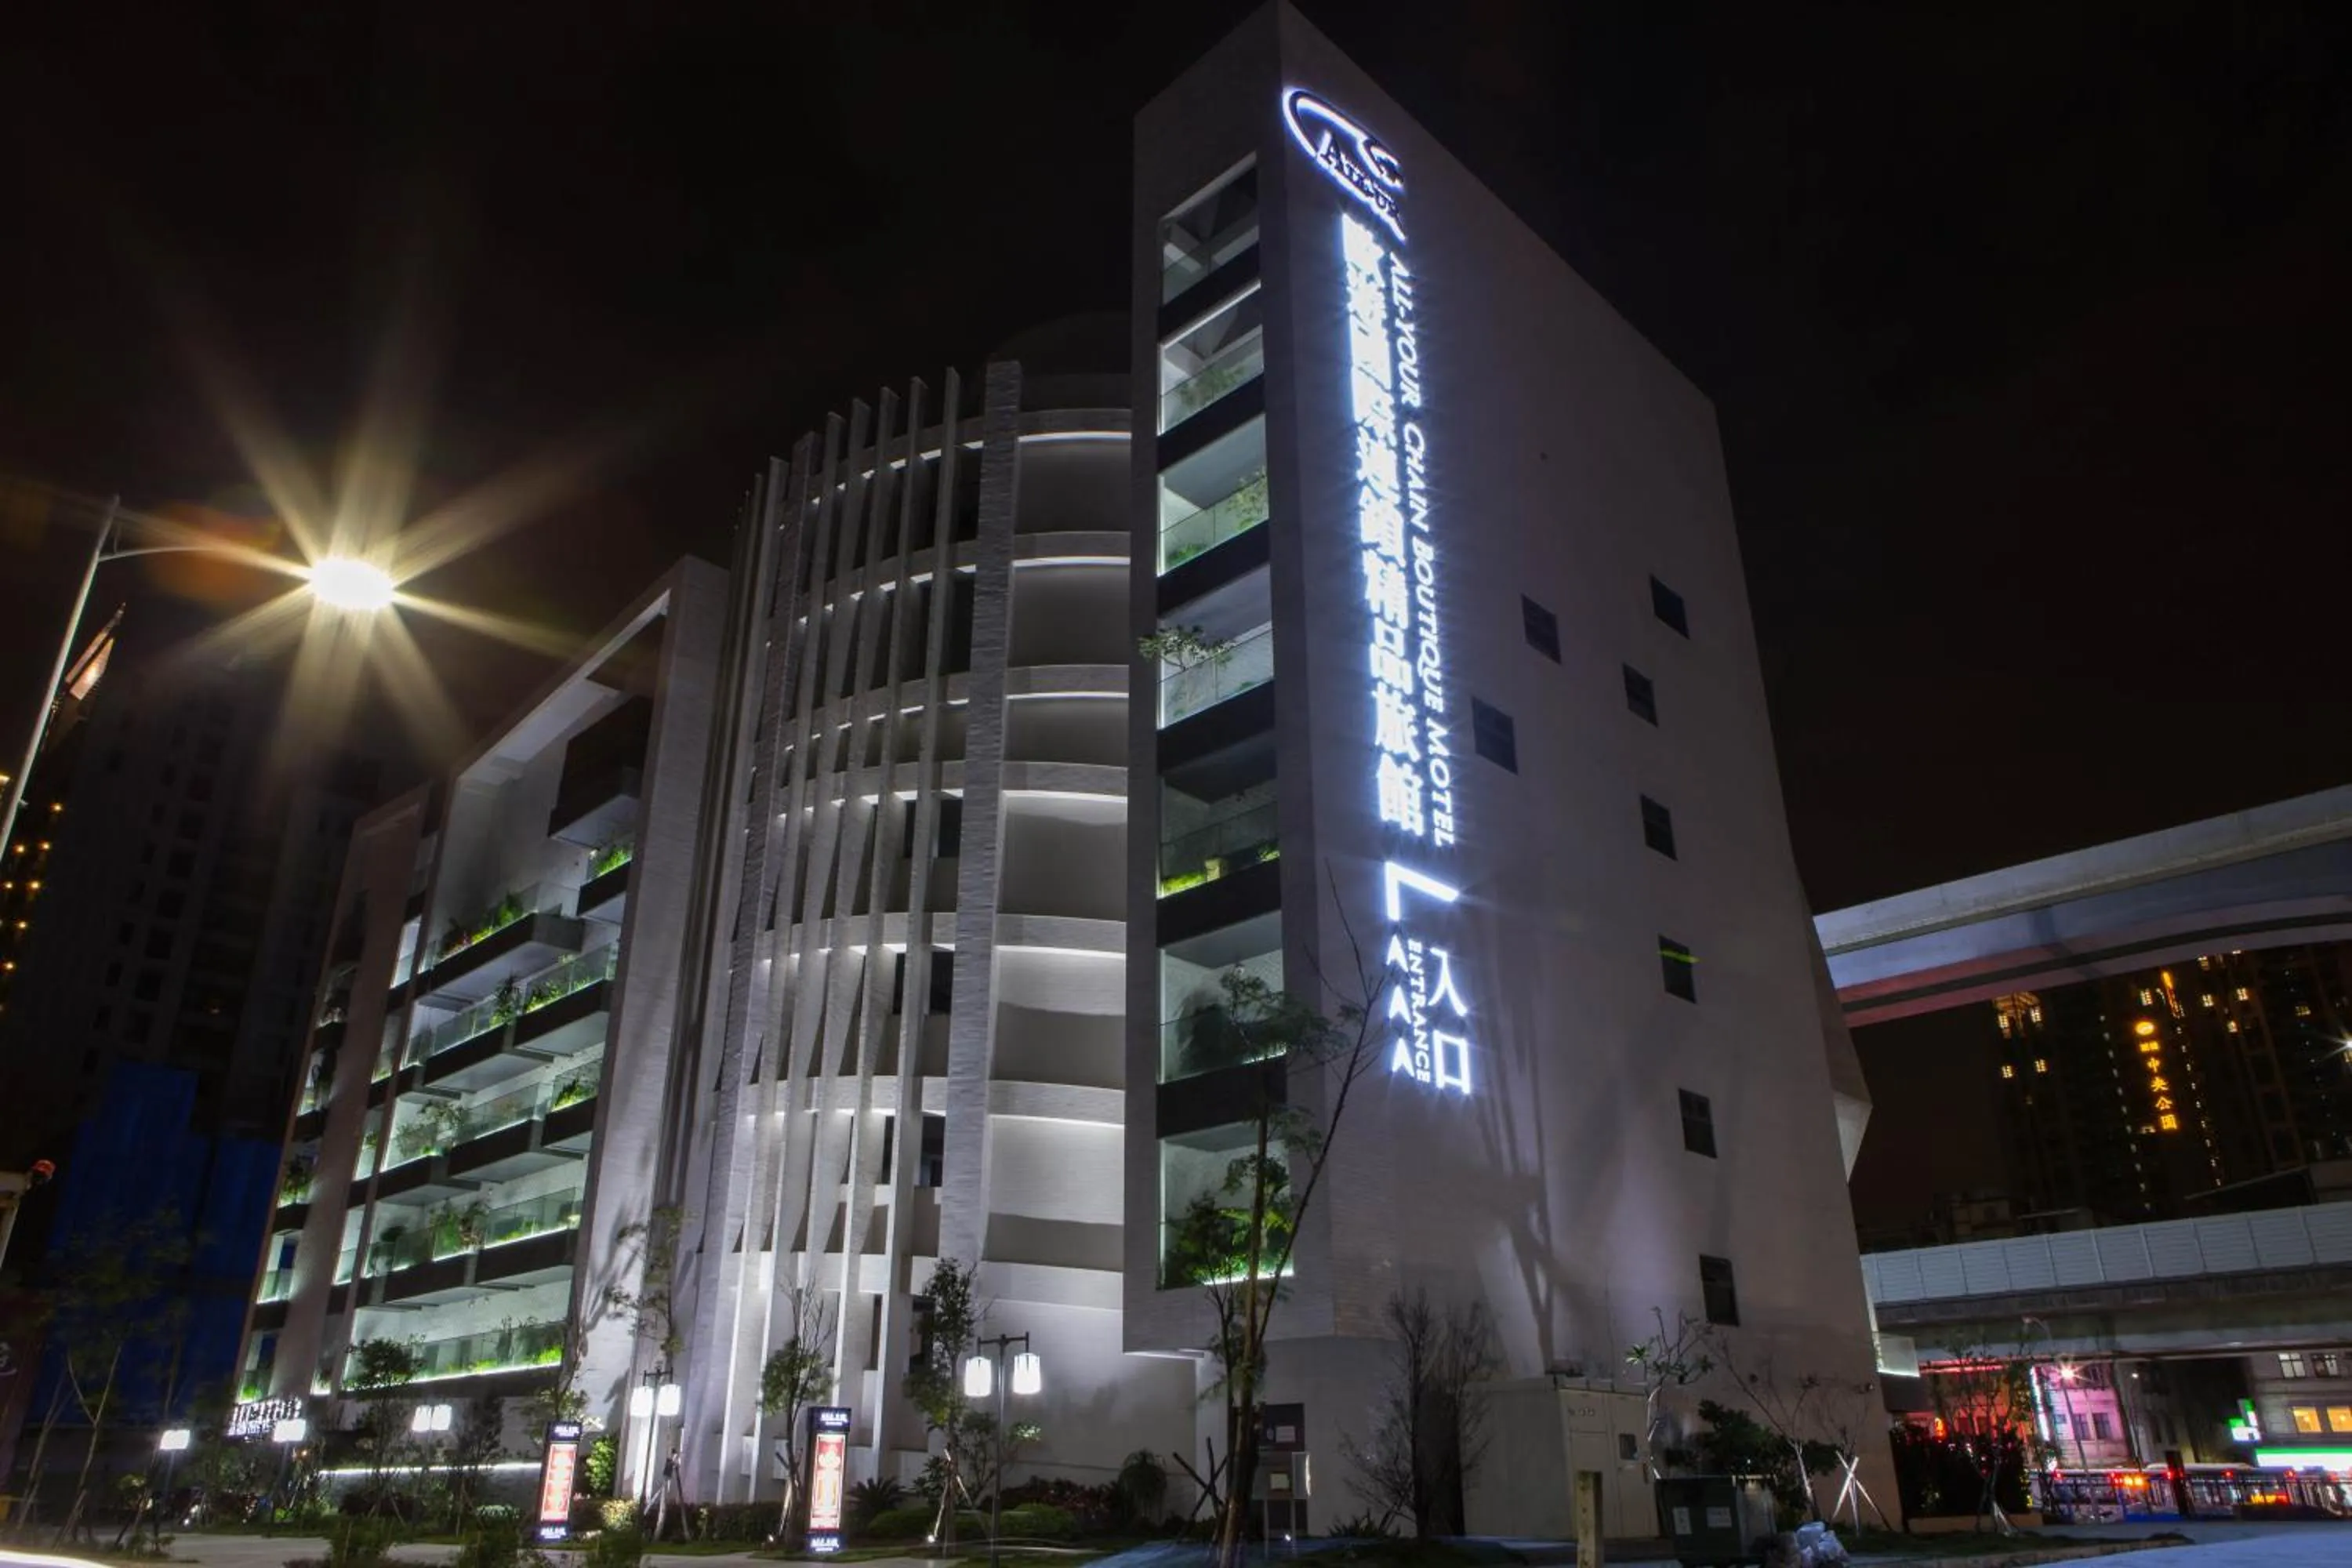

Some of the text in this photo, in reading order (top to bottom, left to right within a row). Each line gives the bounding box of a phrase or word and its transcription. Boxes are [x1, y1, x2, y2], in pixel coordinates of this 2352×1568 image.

[1390, 251, 1455, 846] ALL-YOUR CHAIN BOUTIQUE MOTEL
[1407, 938, 1431, 1083] ENTRANCE
[1428, 946, 1472, 1095] 入口
[2147, 1056, 2178, 1130] 中央公園
